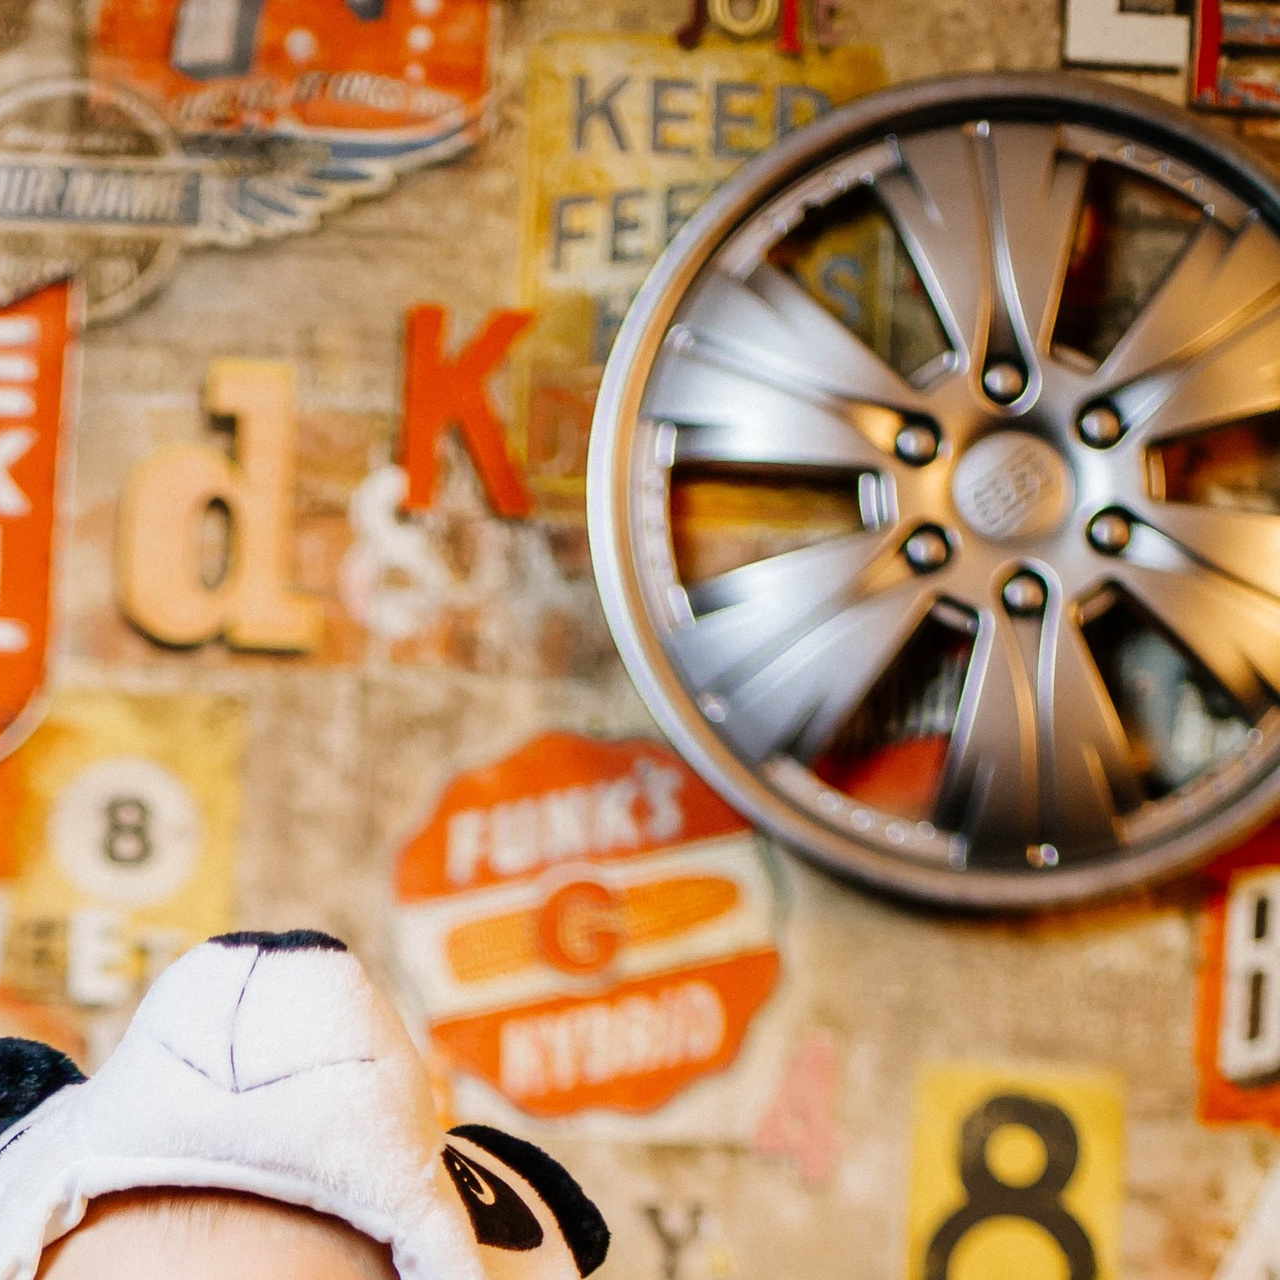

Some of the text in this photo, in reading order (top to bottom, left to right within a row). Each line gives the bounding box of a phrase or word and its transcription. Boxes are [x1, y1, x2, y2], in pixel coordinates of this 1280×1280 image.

[550, 180, 730, 270] FEE
[403, 305, 531, 520] K
[122, 358, 322, 648] d
[102, 798, 152, 867] 8
